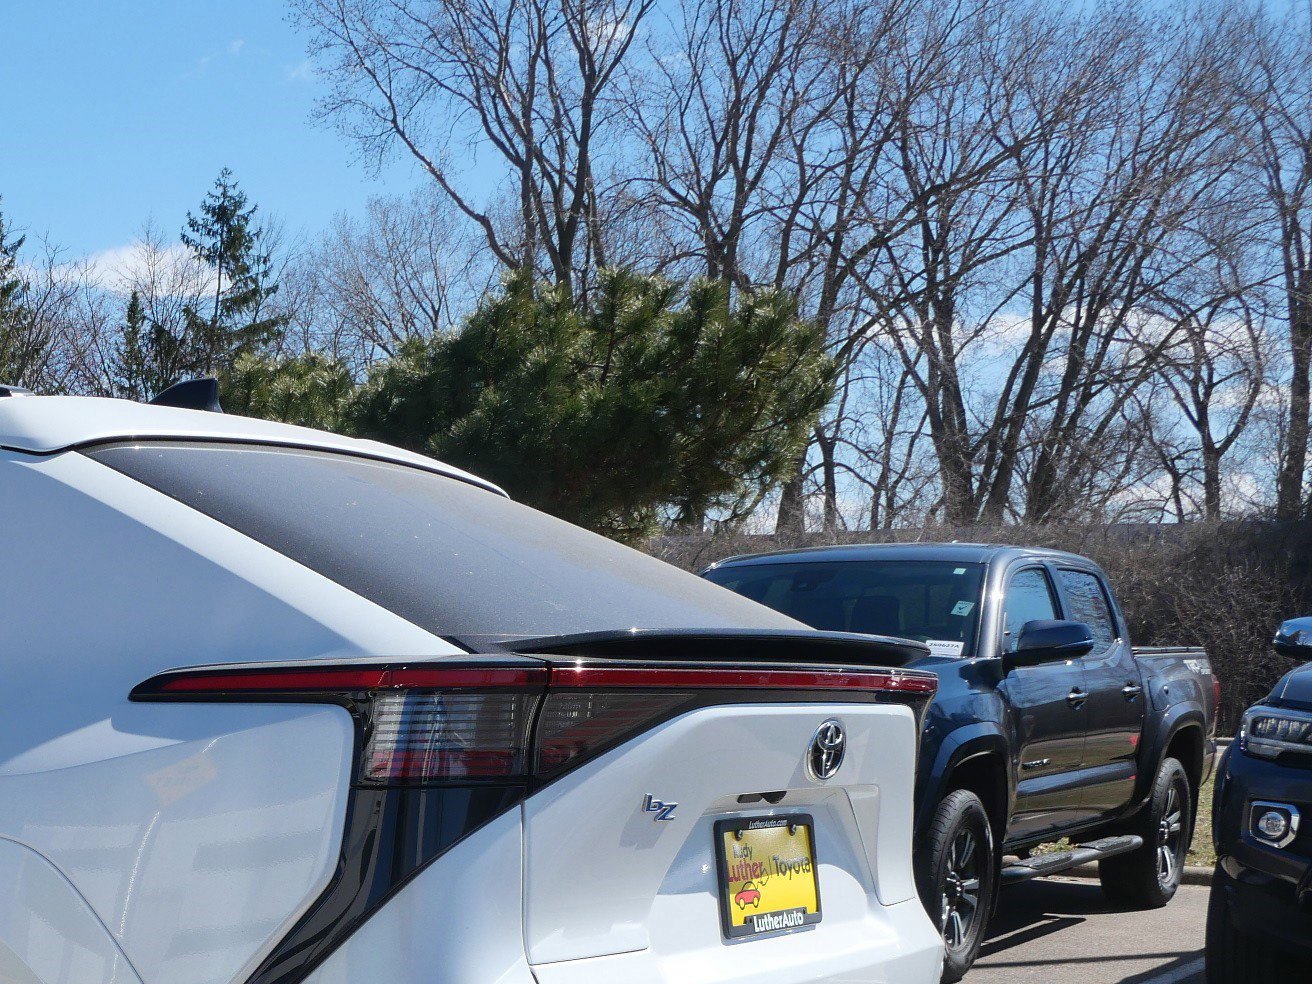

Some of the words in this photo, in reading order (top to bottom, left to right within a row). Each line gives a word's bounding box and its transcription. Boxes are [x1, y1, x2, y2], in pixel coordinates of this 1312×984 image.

[748, 820, 788, 829] LutherAuto.com
[732, 843, 753, 860] Rudy
[727, 860, 764, 882] Luther
[773, 855, 812, 880] Toyota
[753, 911, 804, 932] LutherAuto
